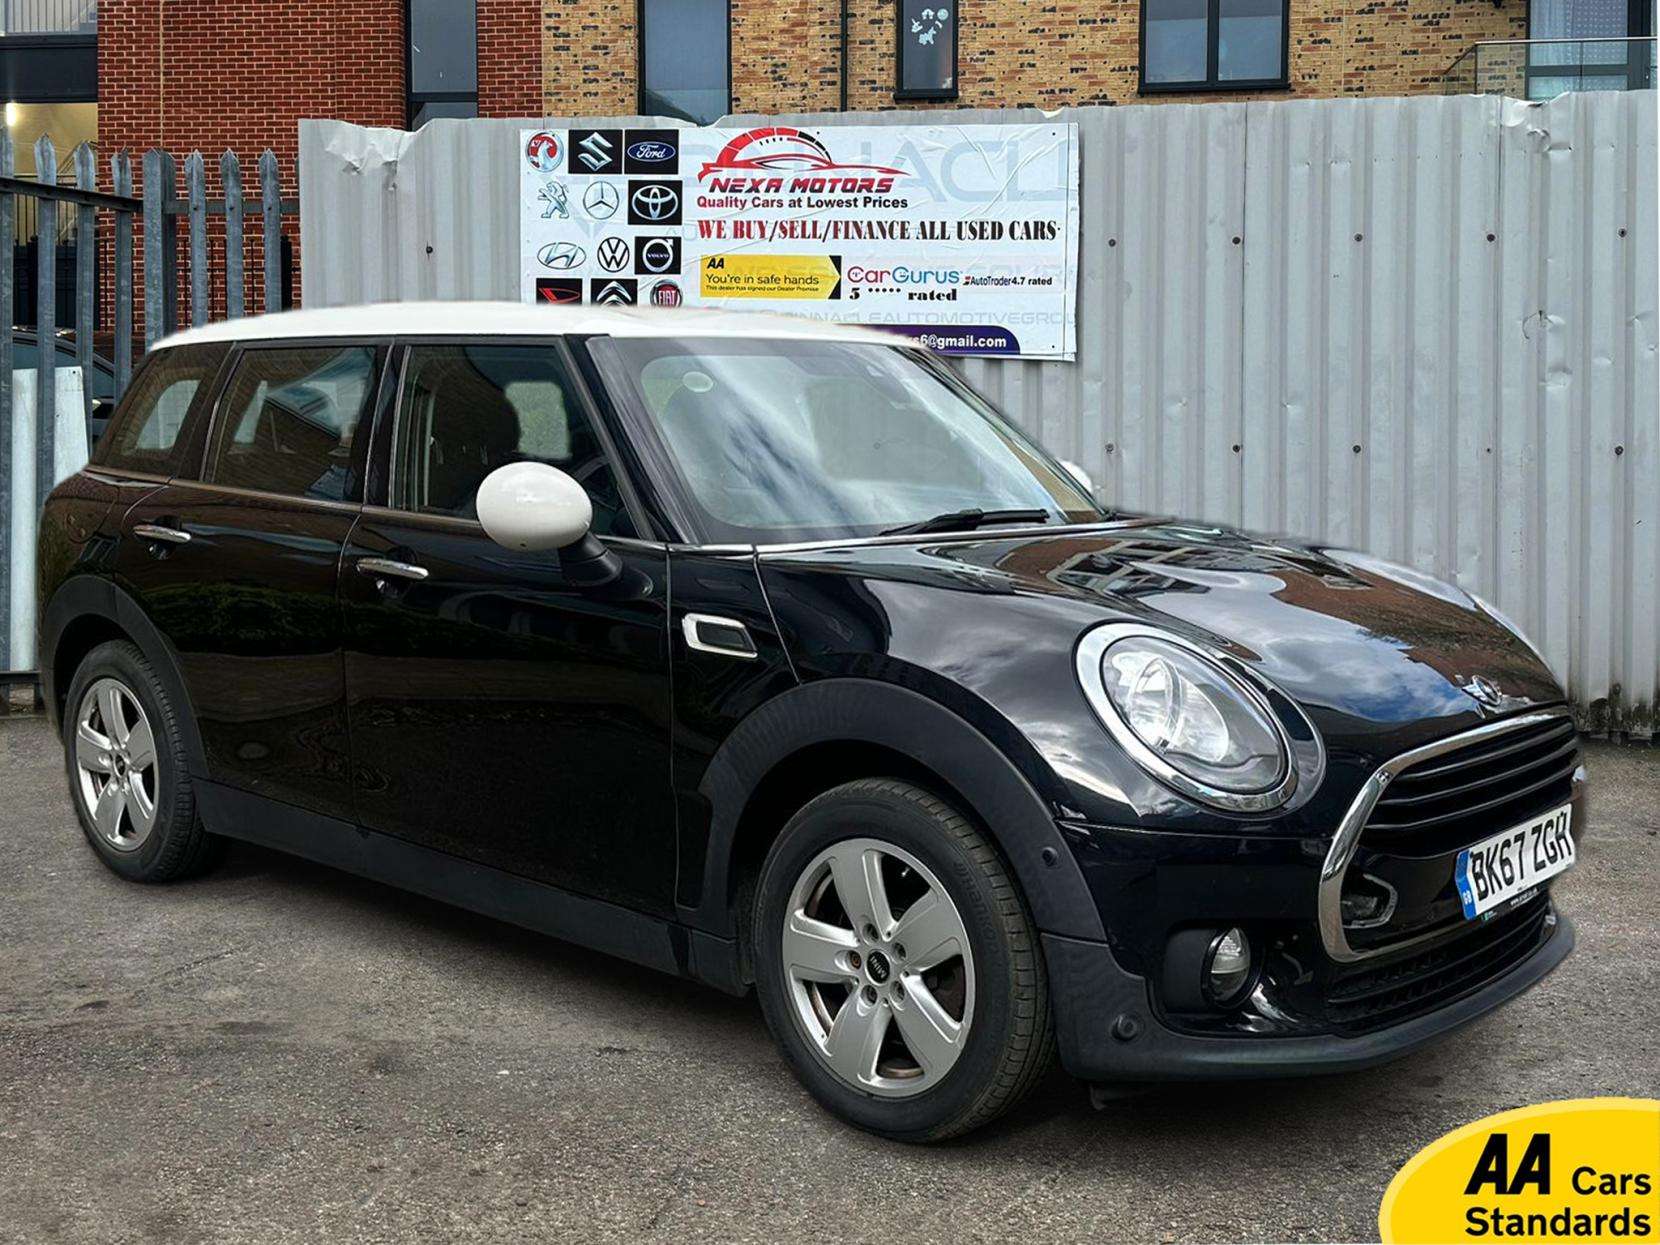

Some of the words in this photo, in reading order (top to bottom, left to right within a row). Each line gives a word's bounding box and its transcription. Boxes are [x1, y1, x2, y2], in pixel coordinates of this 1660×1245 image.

[637, 145, 665, 158] Ford
[709, 178, 783, 193] NEXA
[789, 178, 894, 193] MOTORS
[697, 196, 747, 210] Quality
[752, 197, 784, 208] Cars
[788, 197, 802, 208] at
[807, 196, 858, 208] Lowest
[863, 196, 908, 208] Prices
[697, 220, 726, 240] WE
[917, 221, 950, 240] ALL
[957, 221, 1003, 240] USED
[1009, 221, 1056, 240] CARS
[707, 258, 725, 269] AA
[706, 274, 741, 284] You're
[744, 274, 754, 283] in
[757, 274, 781, 284] safe
[784, 275, 819, 285] hands
[847, 266, 960, 284] CarGurus
[1028, 277, 1052, 285] rated
[658, 290, 677, 306] FIAT
[850, 288, 860, 300] 5
[908, 288, 957, 301] rated
[1470, 831, 1526, 901] BK67
